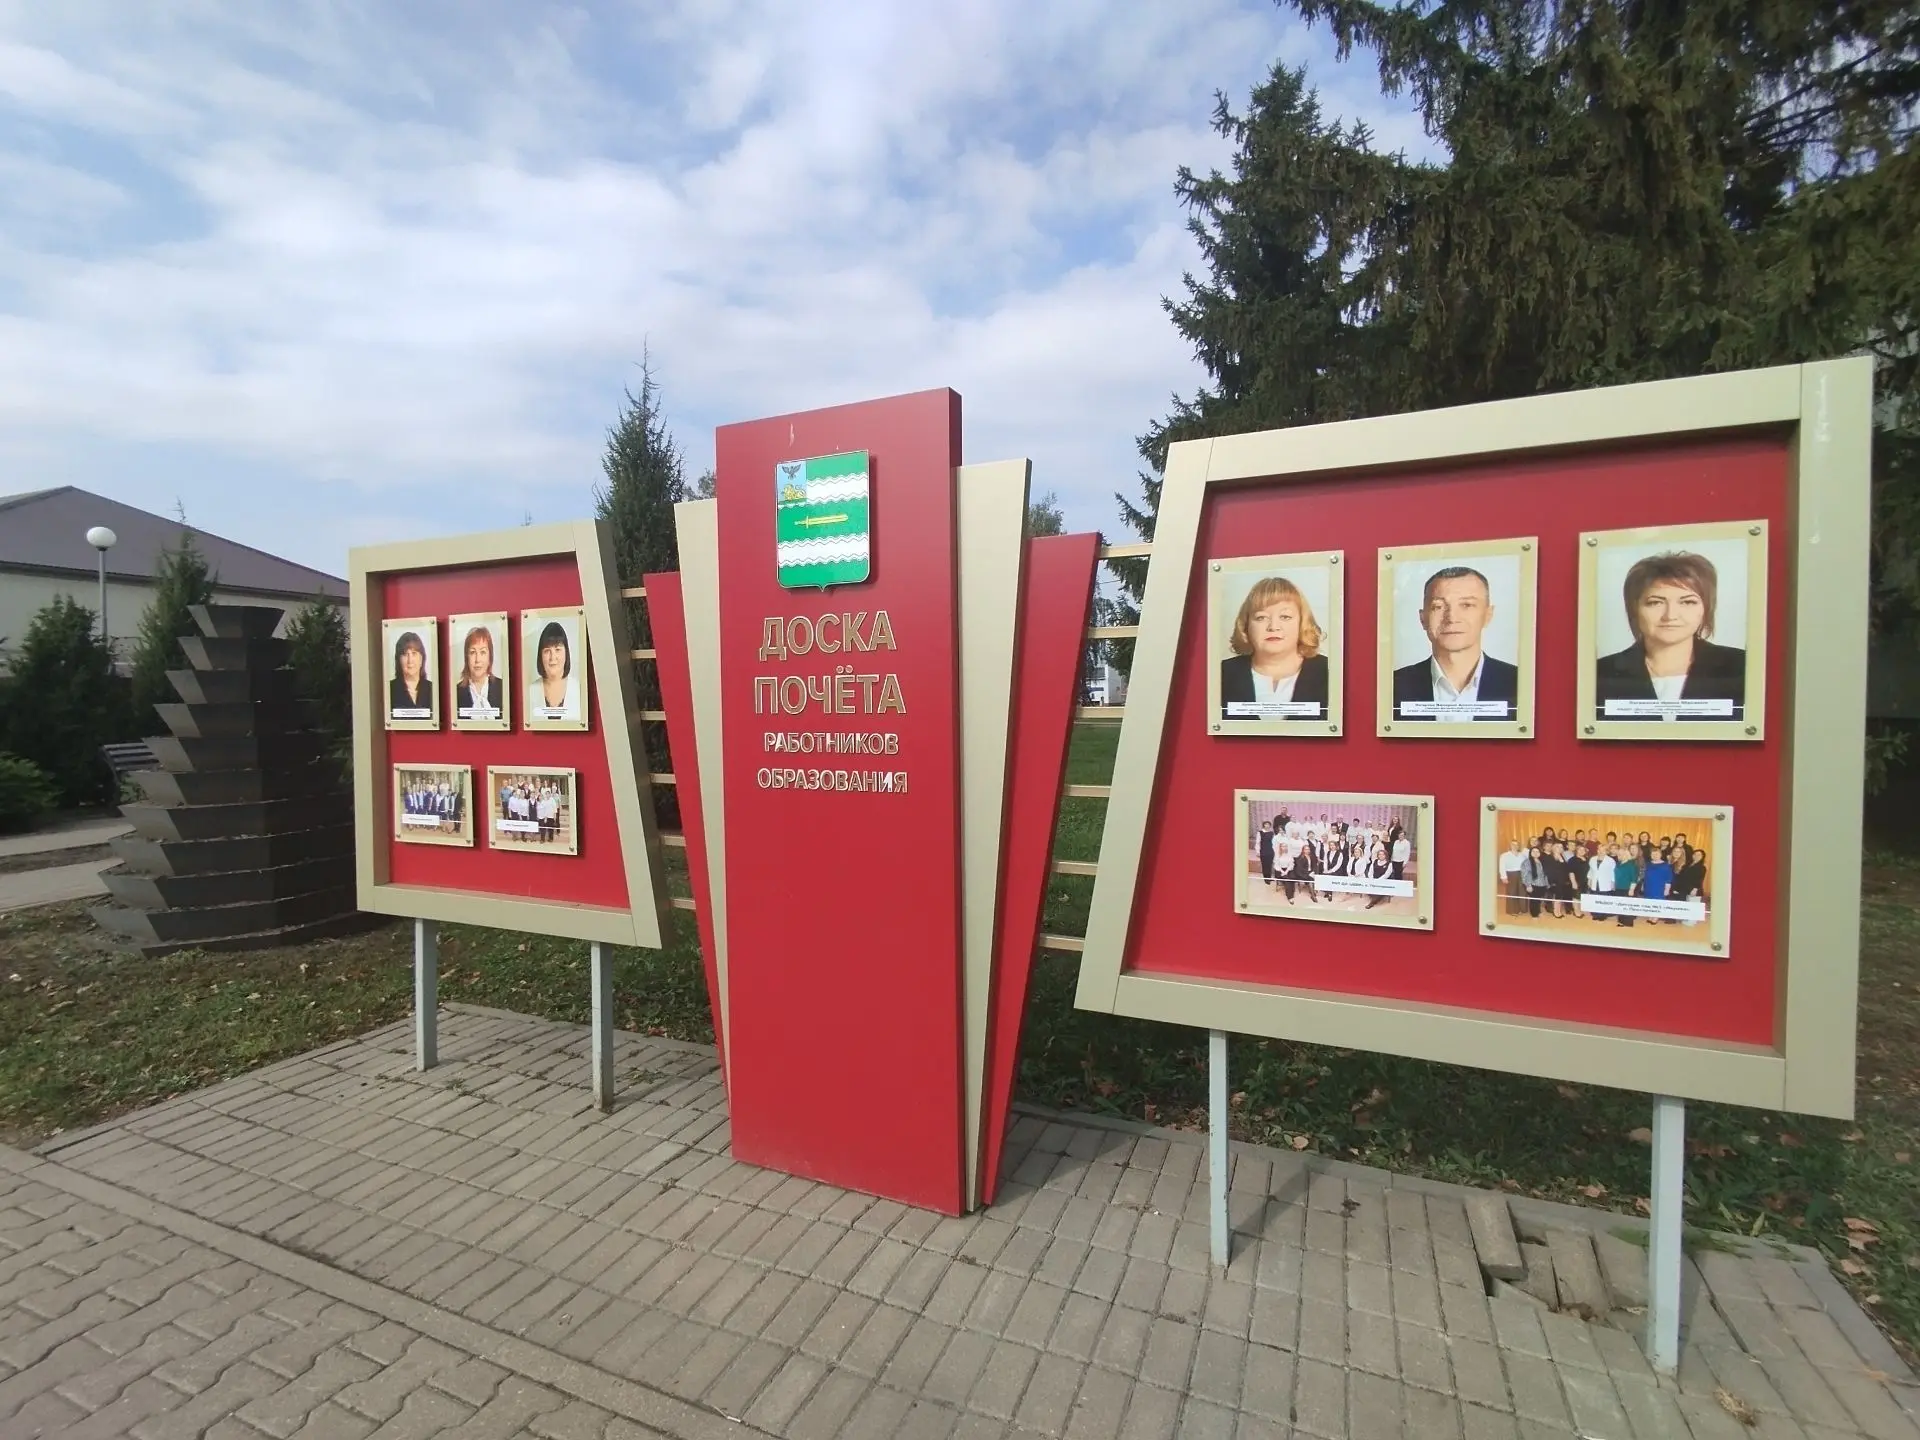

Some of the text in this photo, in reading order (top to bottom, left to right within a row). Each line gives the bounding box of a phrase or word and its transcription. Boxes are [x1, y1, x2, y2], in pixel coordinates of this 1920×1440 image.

[759, 610, 897, 661] ДОСКА
[754, 665, 907, 715] ПОЧЁТА
[764, 732, 899, 755] РАБОТНИКОВ
[757, 768, 908, 793] ОБРАЗОВАНИЯ
